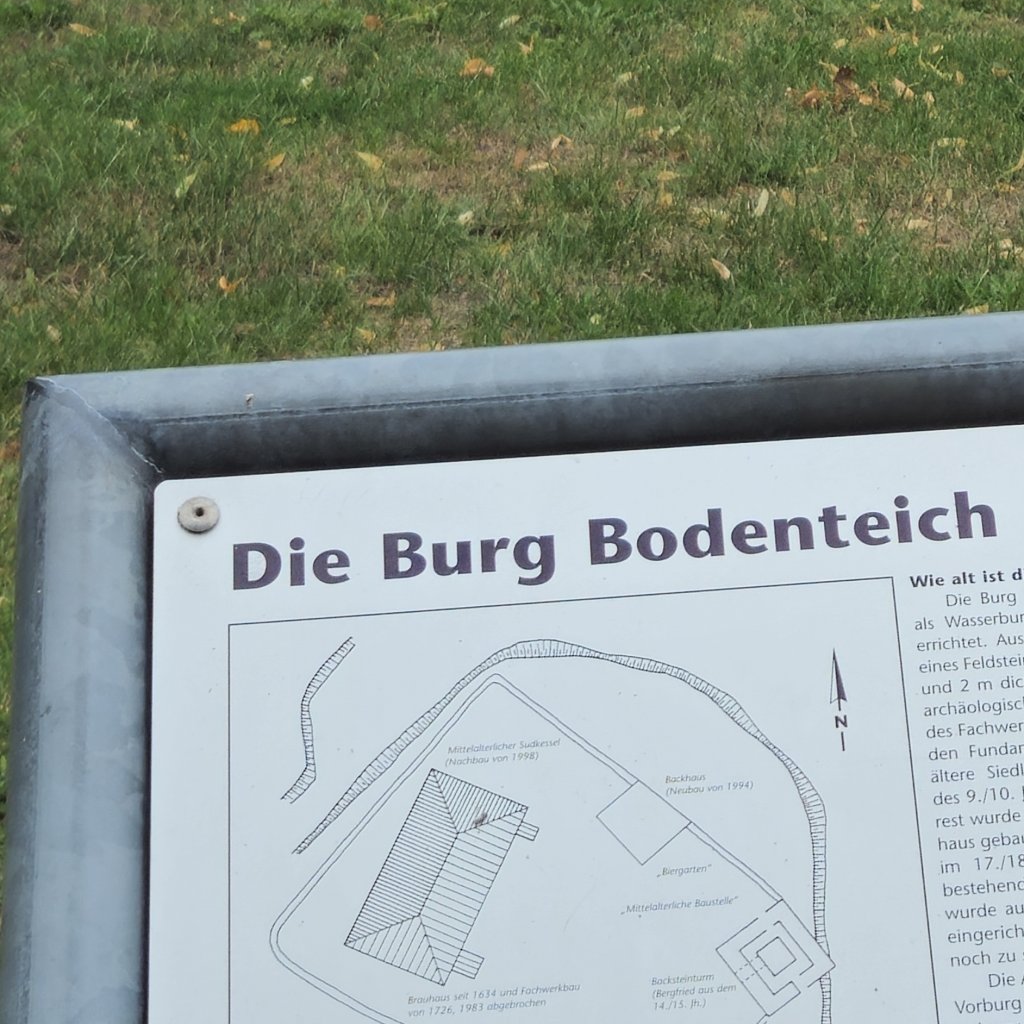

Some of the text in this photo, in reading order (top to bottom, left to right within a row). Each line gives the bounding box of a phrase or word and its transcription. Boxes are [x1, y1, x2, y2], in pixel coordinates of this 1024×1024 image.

[233, 492, 997, 590] Die Burg Bodenteich
[908, 573, 945, 588] Wie
[951, 570, 976, 585] alt
[981, 569, 1005, 583] ist
[945, 592, 972, 607] Die
[979, 591, 1017, 607] Burg
[914, 616, 935, 631] als
[915, 635, 987, 652] errichtet.
[995, 632, 1024, 646] Aus
[918, 658, 959, 674] eines
[920, 679, 952, 695] und
[959, 678, 969, 692] 2
[976, 679, 993, 691] m
[834, 714, 848, 728] N
[925, 724, 953, 739] des
[927, 746, 958, 761] den
[949, 949, 991, 967] noch
[997, 951, 1016, 964] zu
[987, 971, 1016, 988] Die
[953, 997, 1022, 1014] Vorburg
